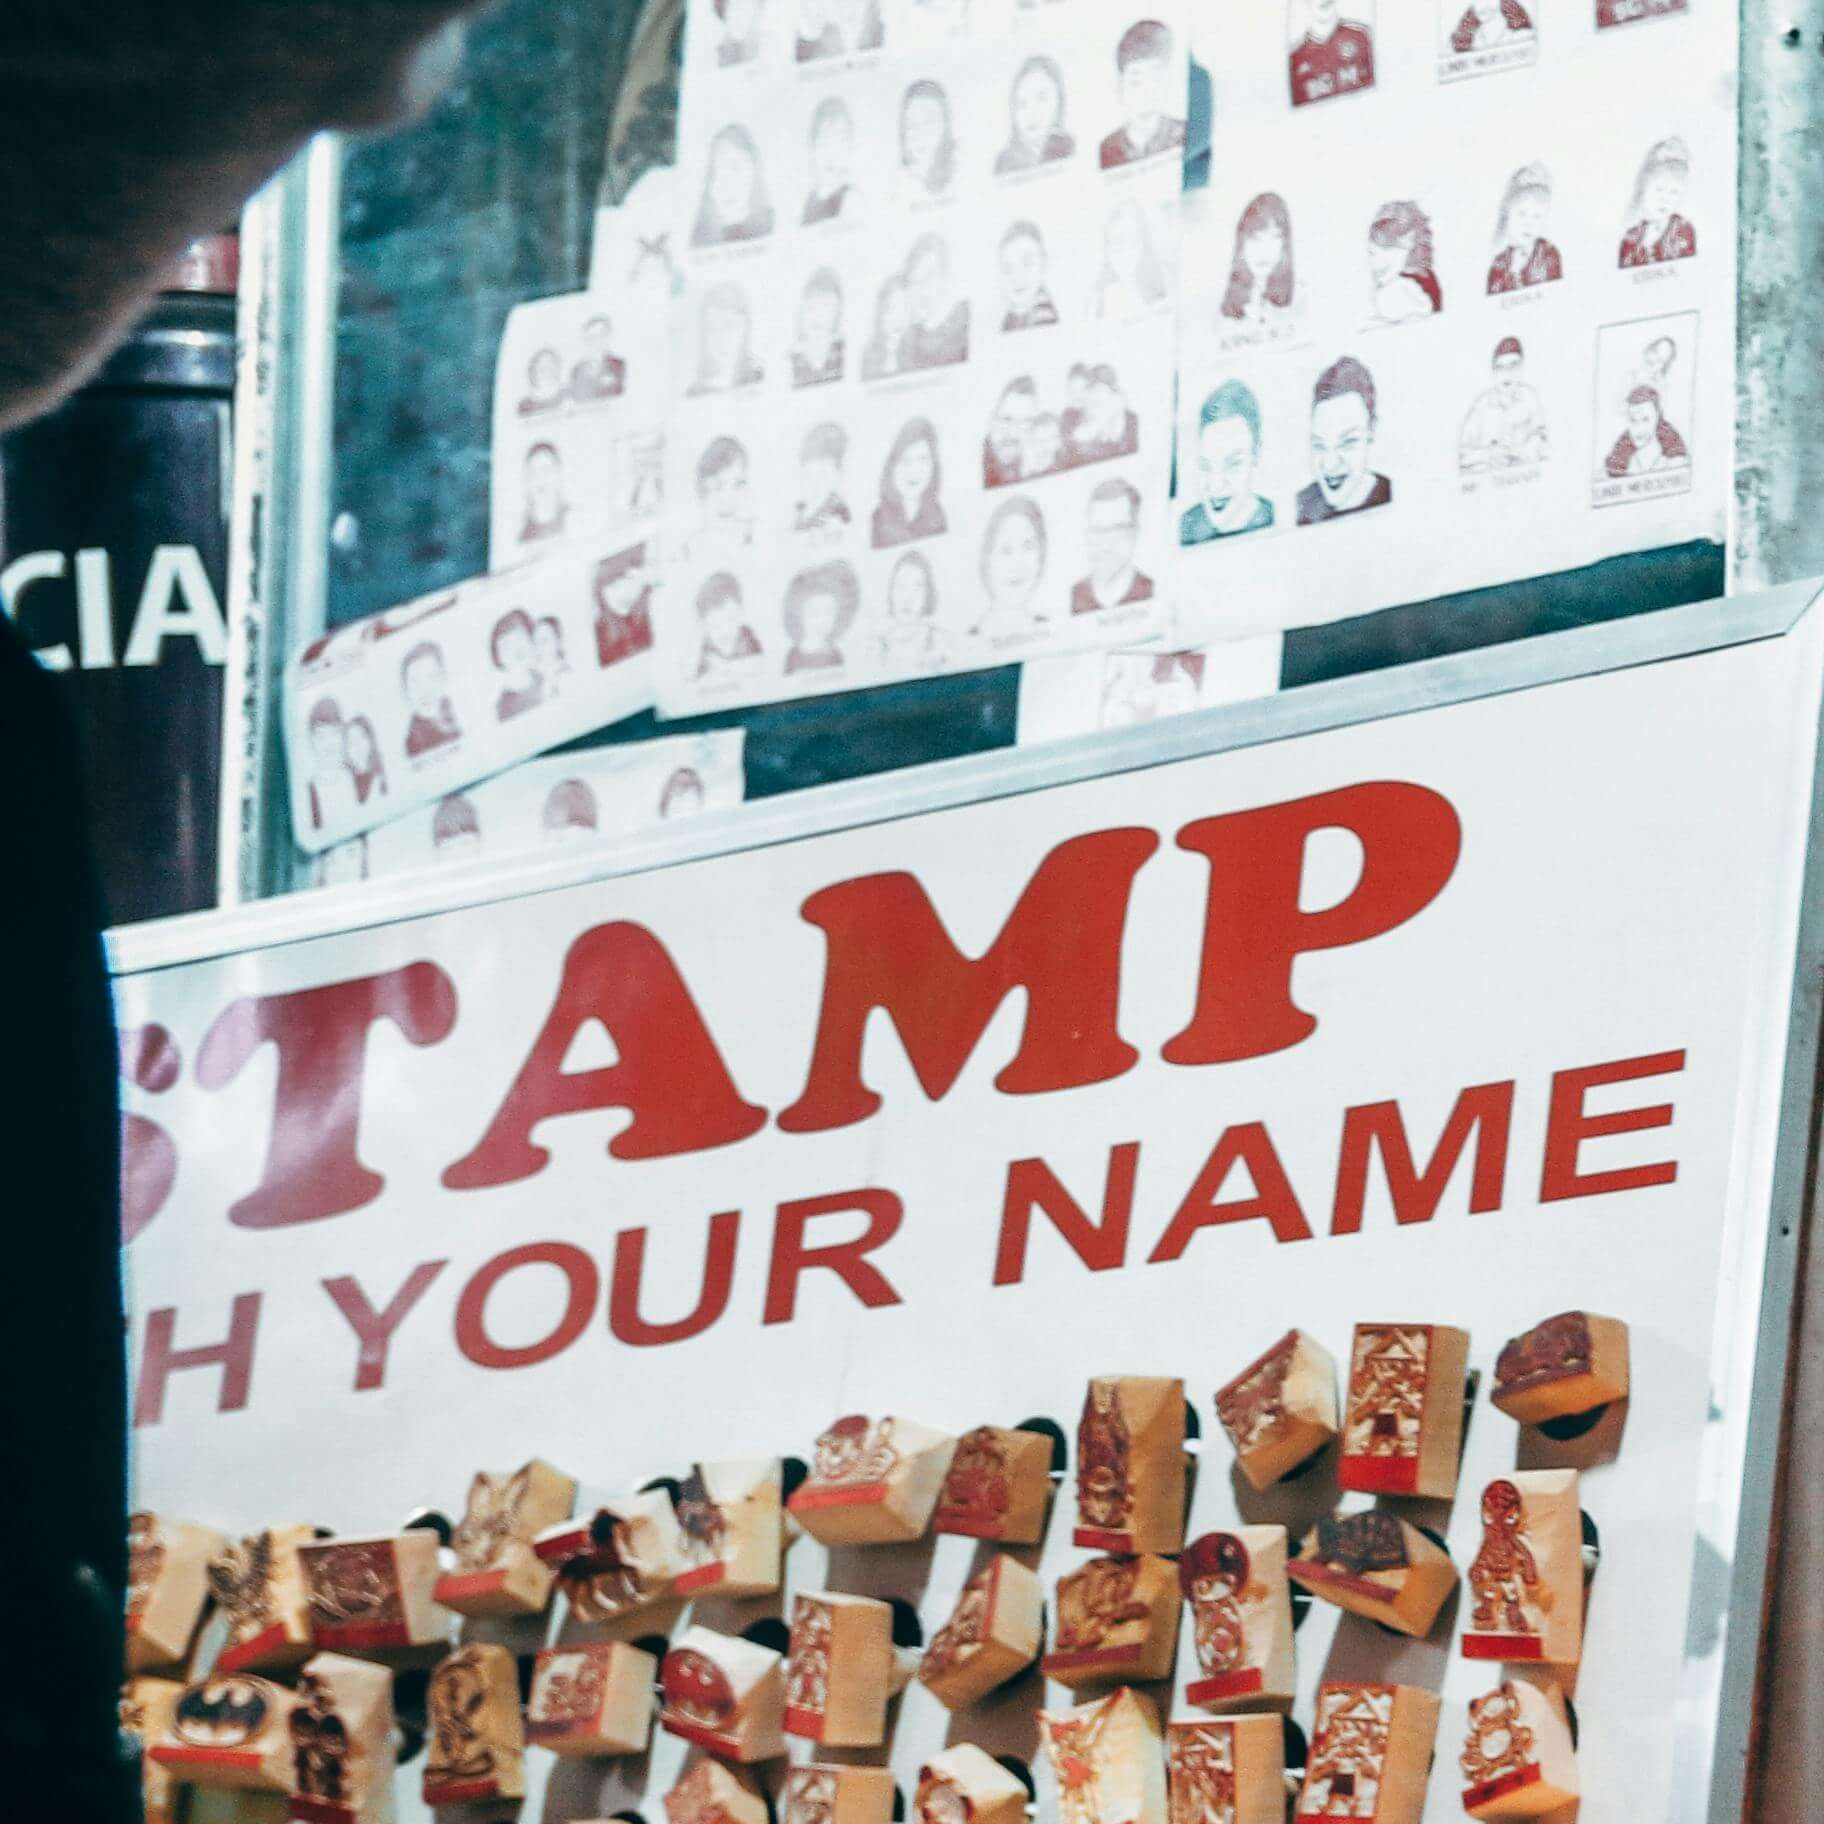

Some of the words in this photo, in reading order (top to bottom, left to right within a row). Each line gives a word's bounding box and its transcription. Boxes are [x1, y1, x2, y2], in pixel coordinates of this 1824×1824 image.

[126, 1290, 263, 1428] H
[322, 1188, 904, 1392] YOUR
[993, 1048, 1688, 1286] NAME
